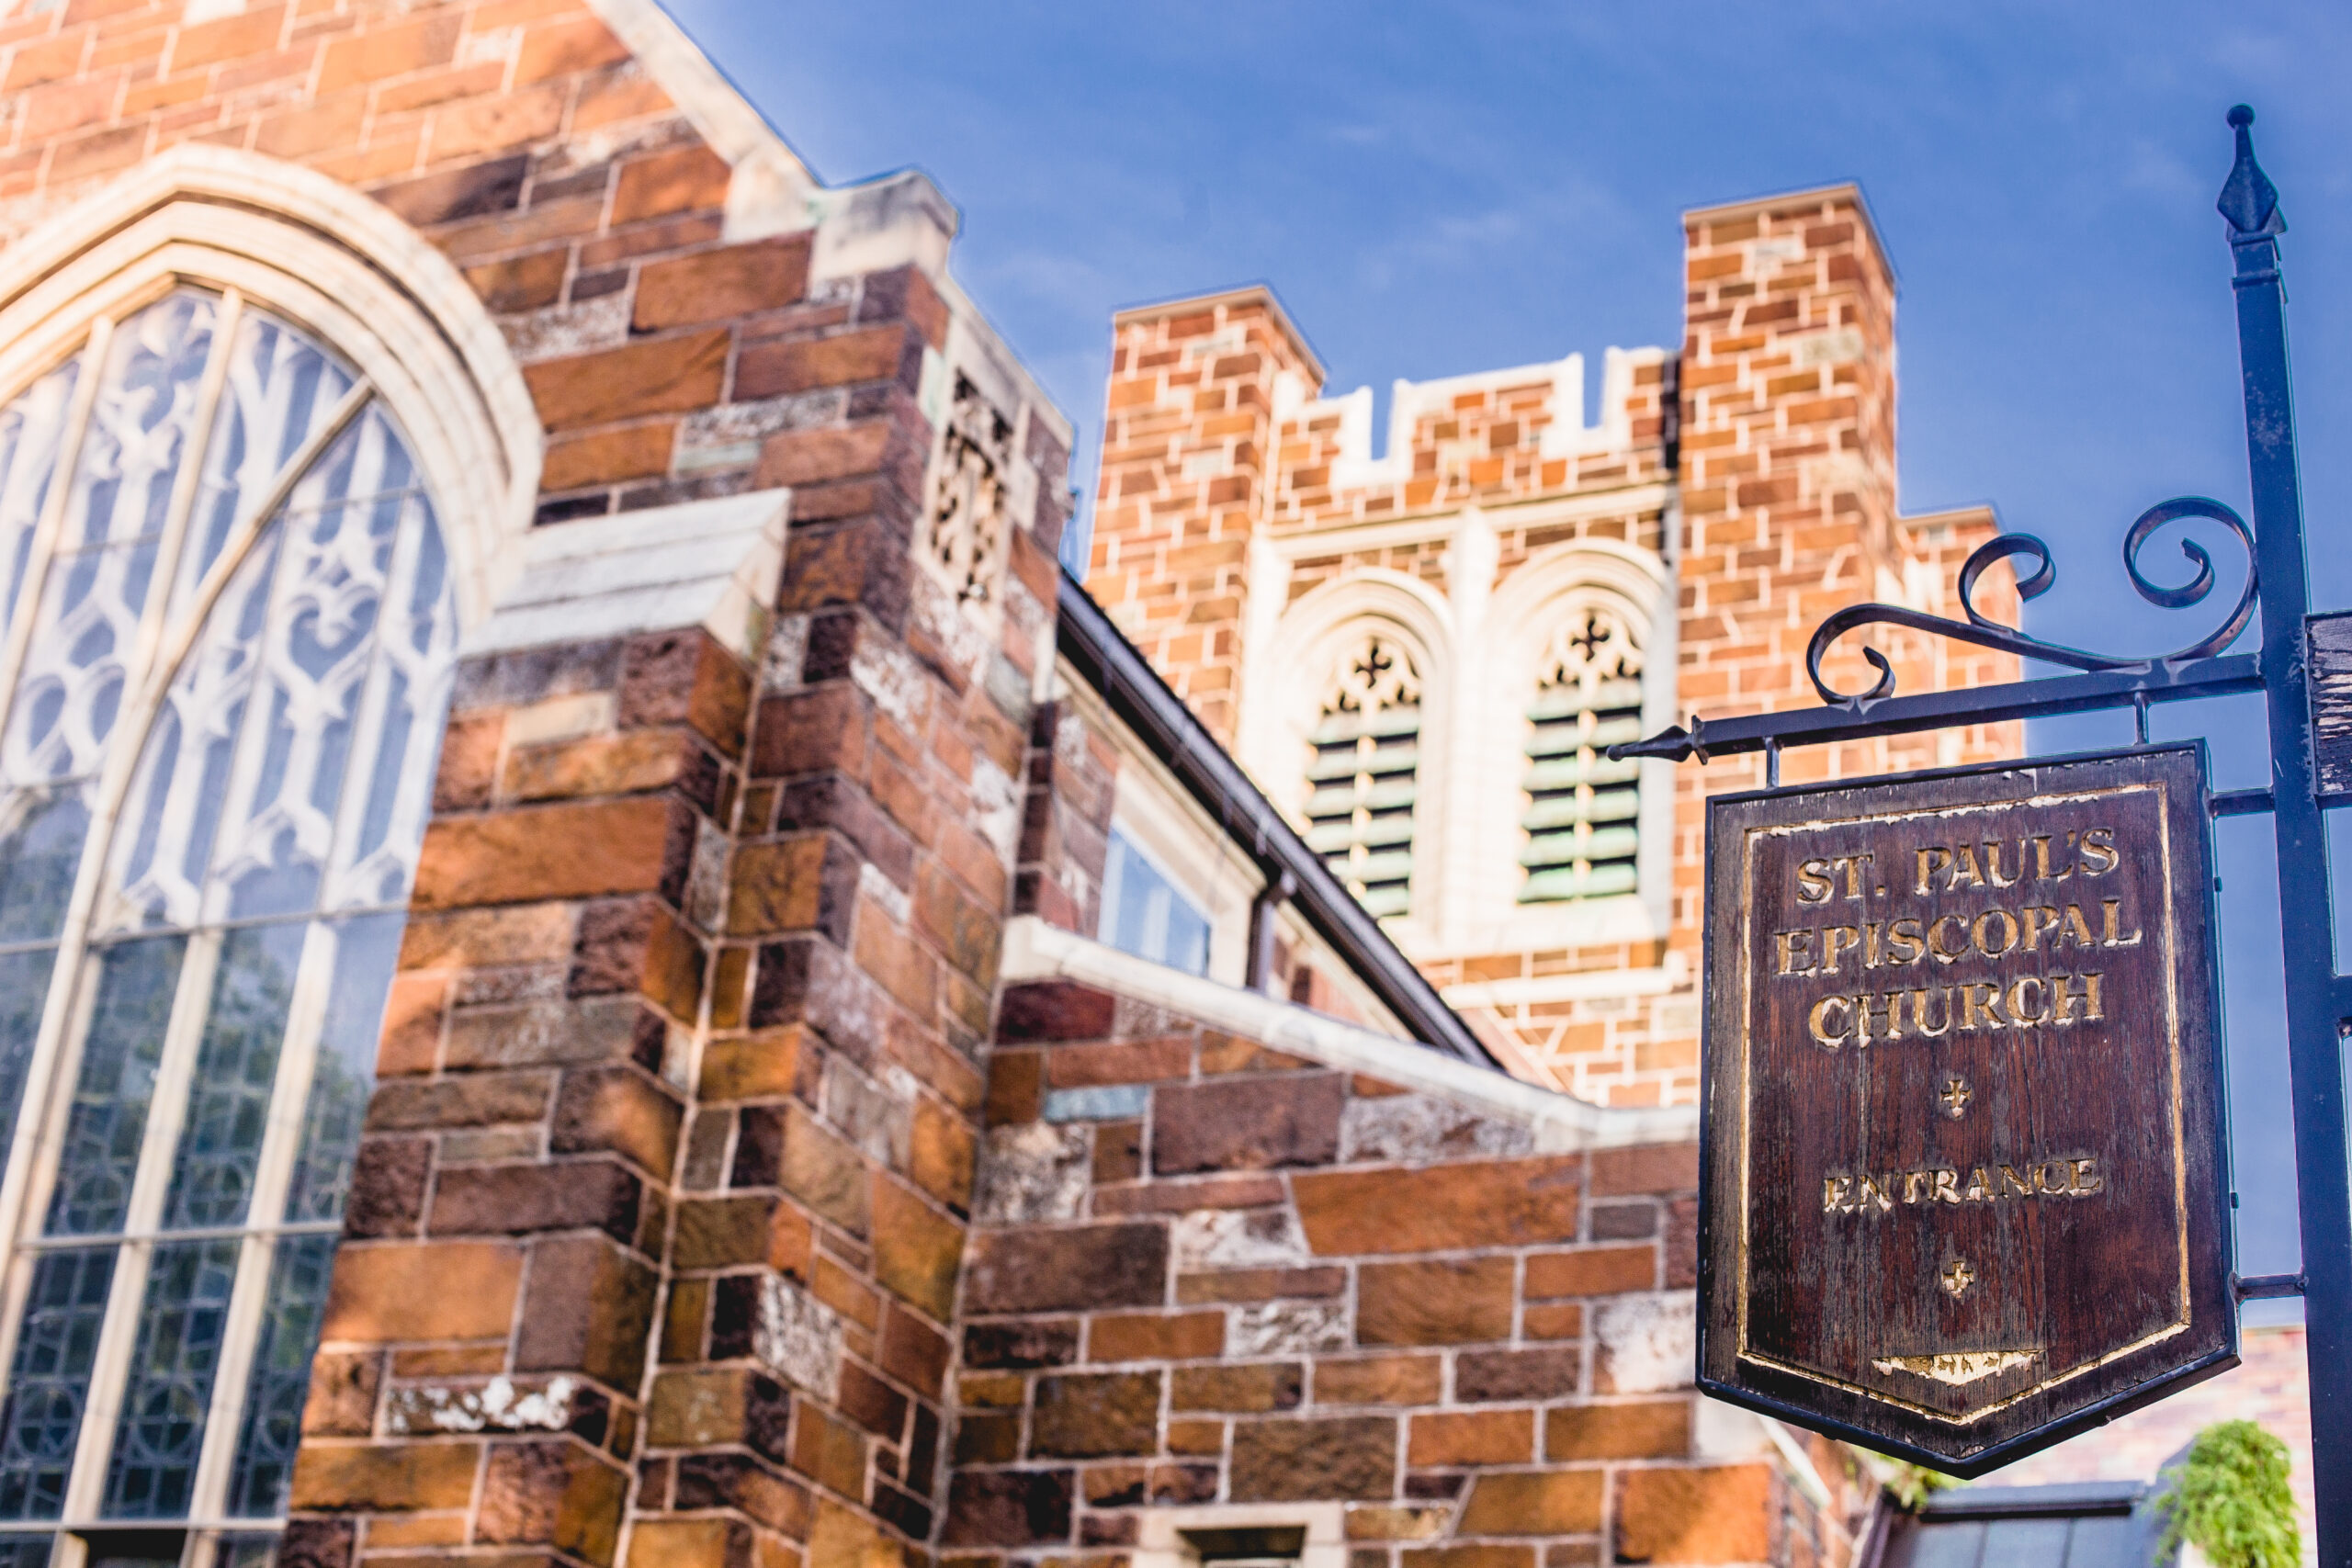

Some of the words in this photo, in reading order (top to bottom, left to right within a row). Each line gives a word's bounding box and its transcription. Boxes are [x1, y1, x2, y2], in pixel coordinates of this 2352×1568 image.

[1796, 853, 1886, 905] ST.
[1914, 828, 2120, 897] PAUL'S
[1773, 899, 2143, 977] EPISCOPAL
[1808, 973, 2105, 1048] CHURCH
[1823, 1156, 2101, 1213] ENTRANCE
